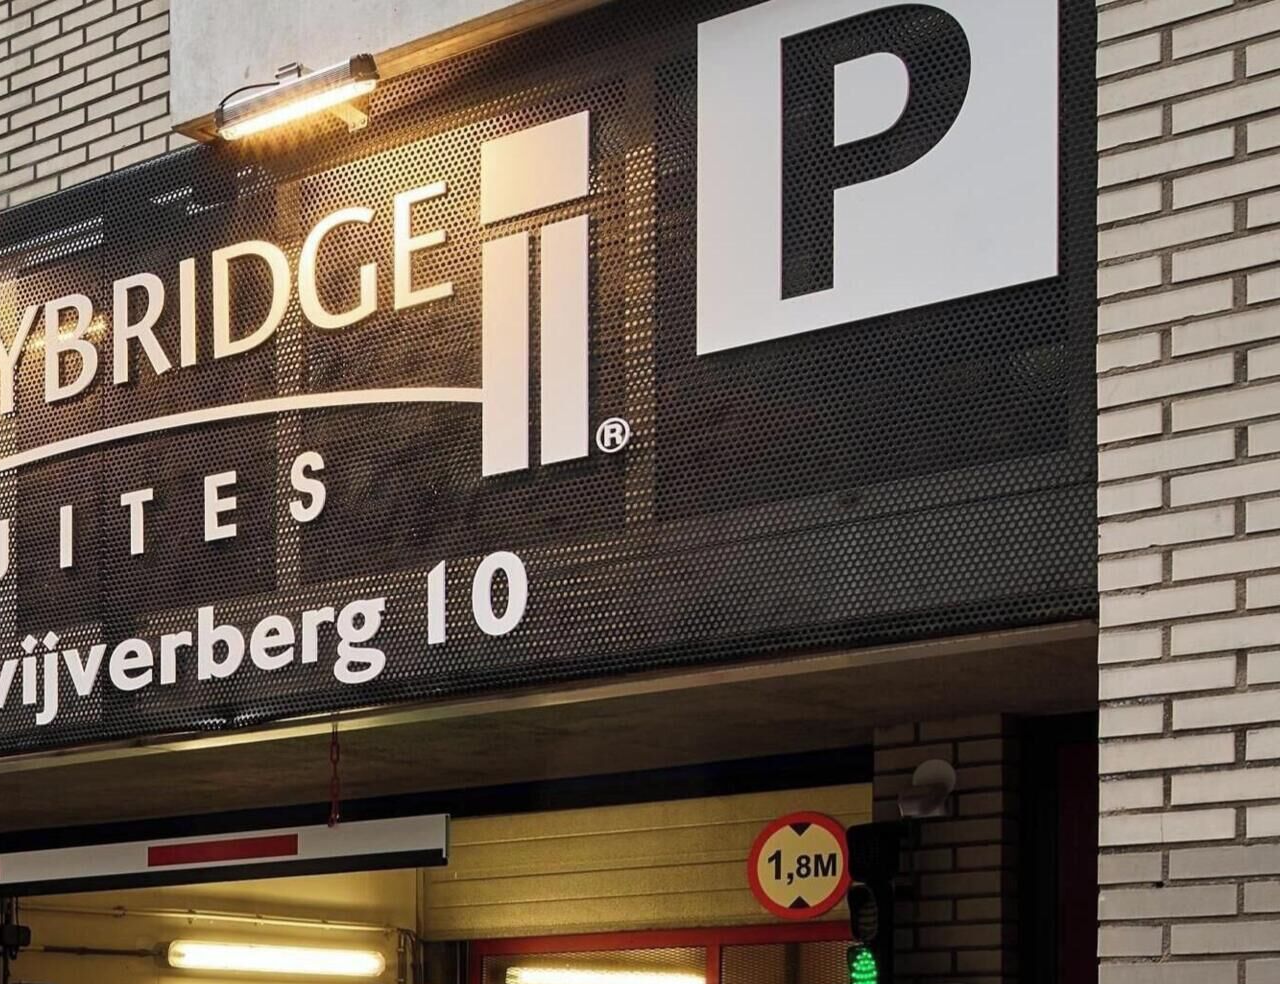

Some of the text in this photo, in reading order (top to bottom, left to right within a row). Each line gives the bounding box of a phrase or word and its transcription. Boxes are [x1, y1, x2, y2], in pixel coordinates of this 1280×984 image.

[780, 3, 971, 300] P
[425, 550, 530, 647] 10
[767, 849, 838, 885] 1,8M
